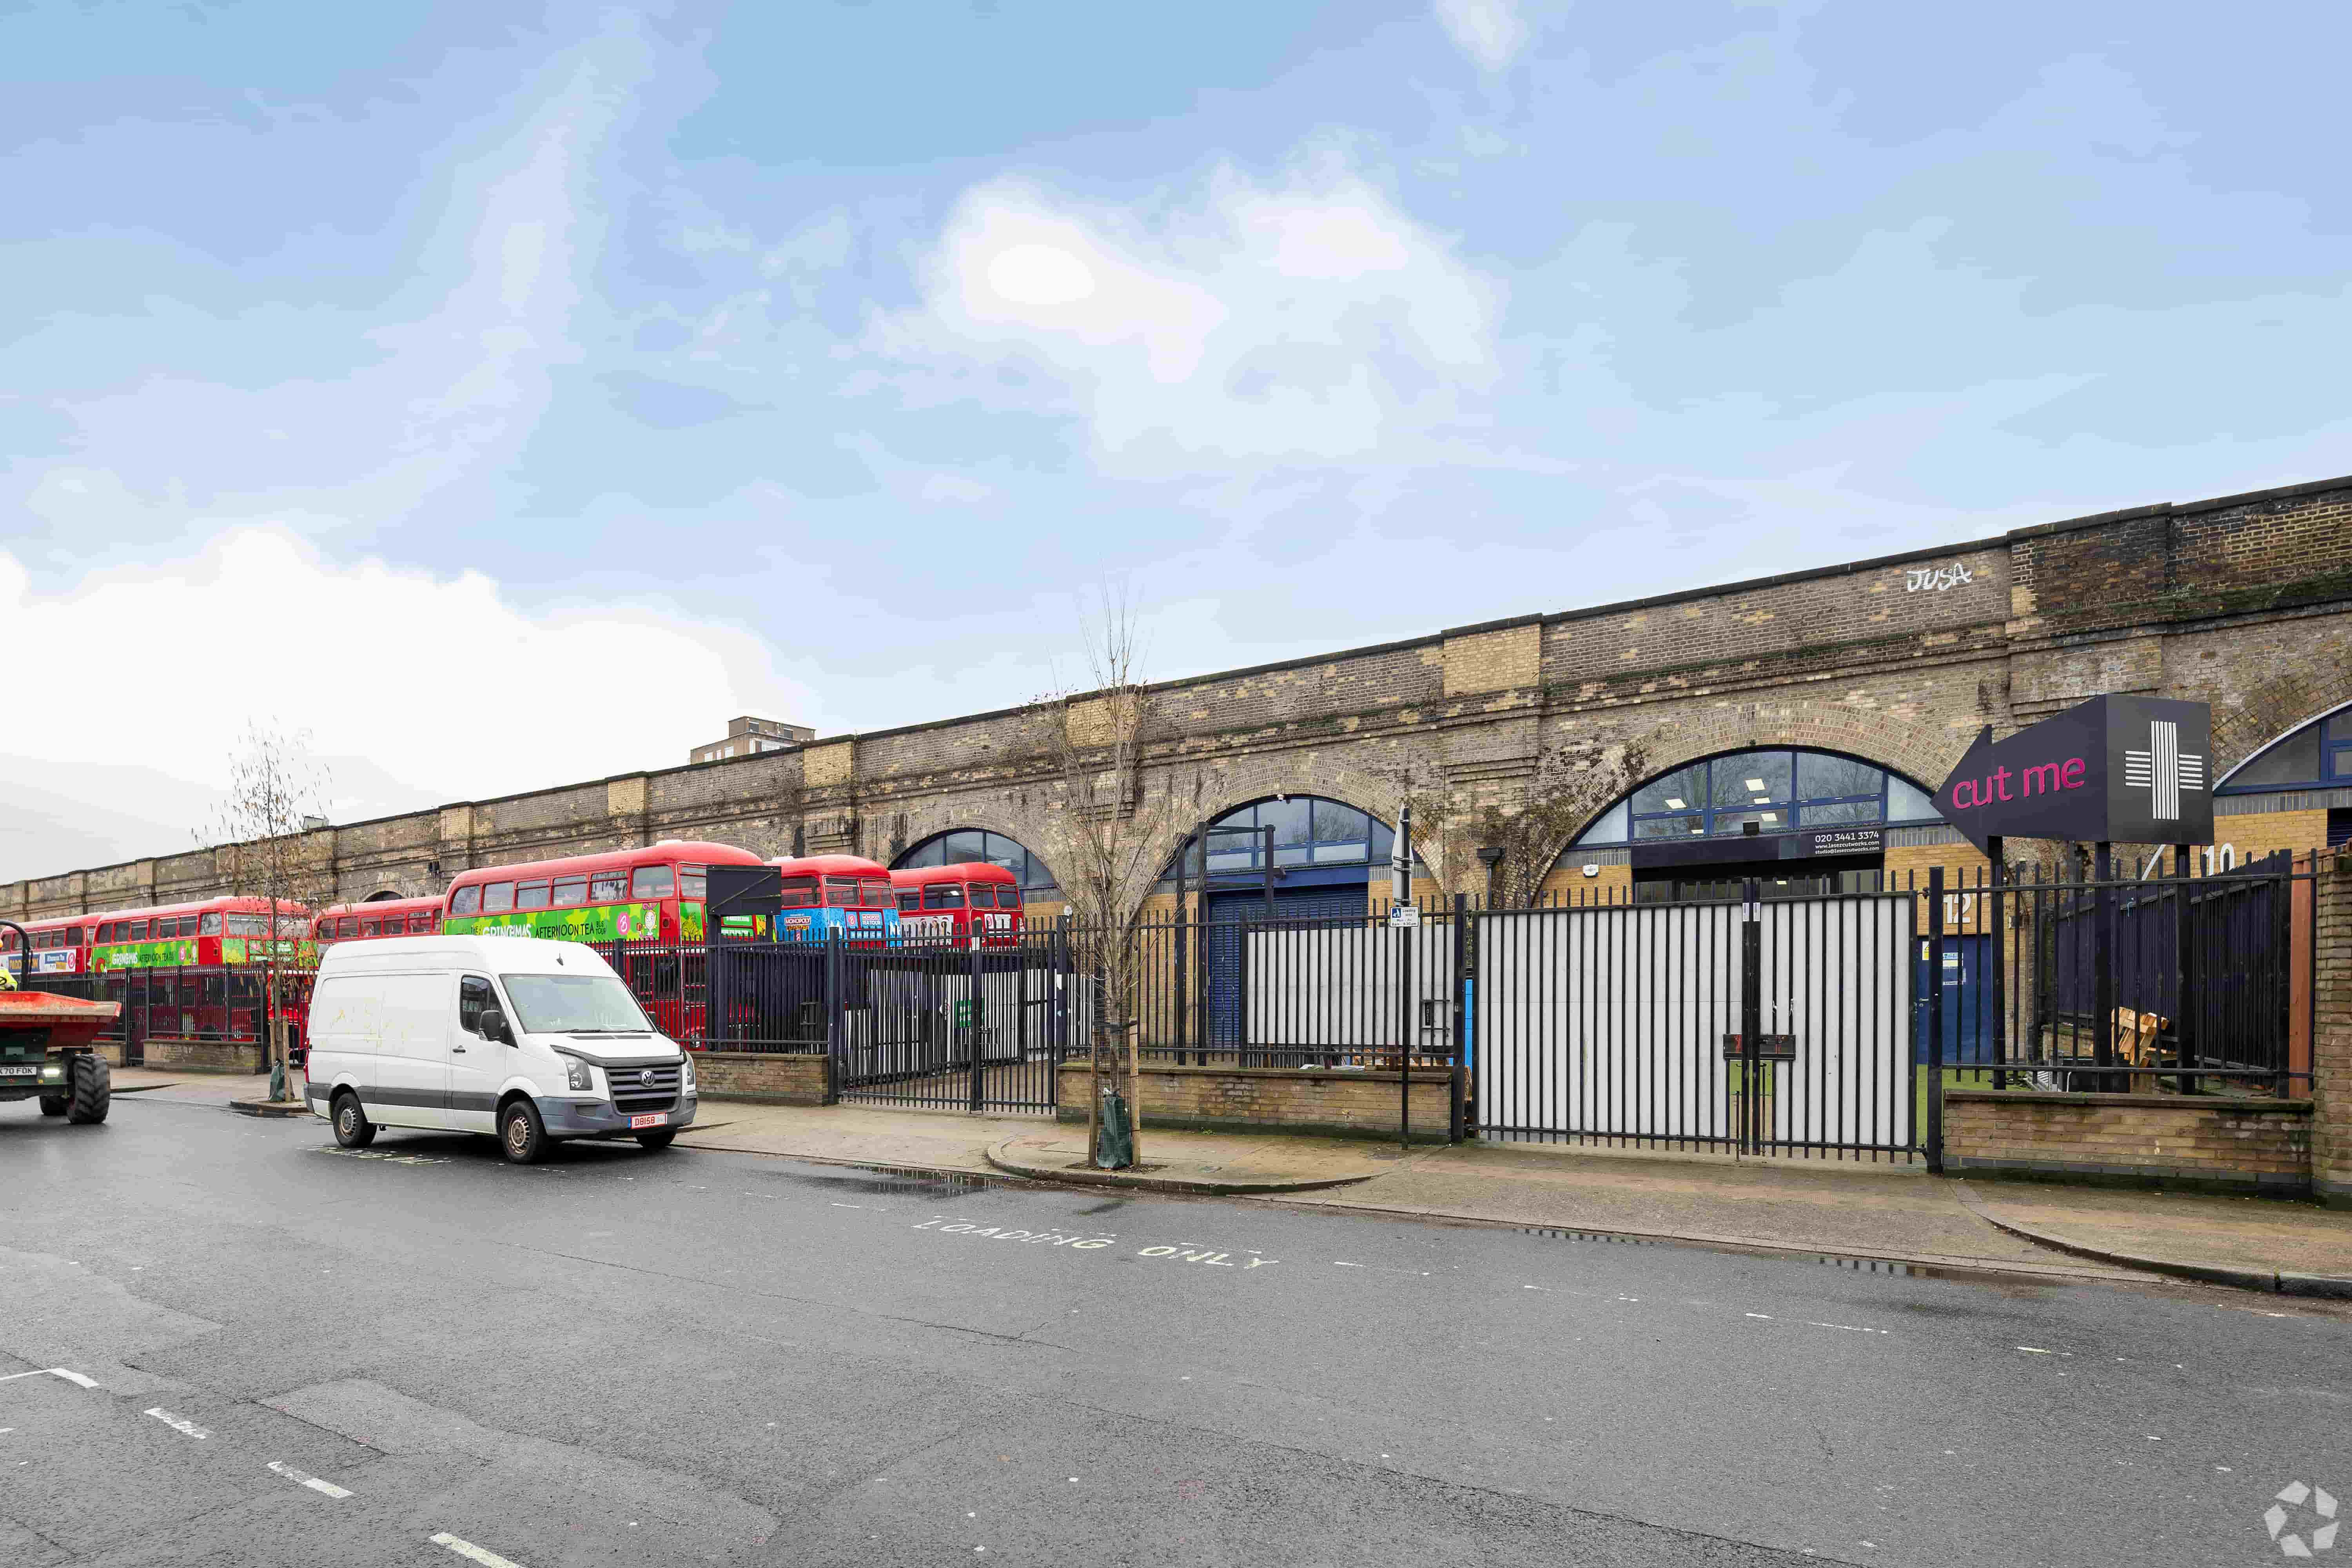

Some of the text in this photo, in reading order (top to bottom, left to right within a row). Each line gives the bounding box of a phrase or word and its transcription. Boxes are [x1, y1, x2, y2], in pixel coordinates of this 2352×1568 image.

[1953, 758, 2086, 809] cut me
[1815, 831, 1879, 843] 020 3441 3374
[1815, 846, 1880, 855] studio@lasercutworks.com
[1943, 894, 1971, 924] 12
[535, 923, 579, 938] AFTERNOON
[581, 922, 594, 935] TEA
[911, 1220, 1279, 1270] LOADING ONLY
